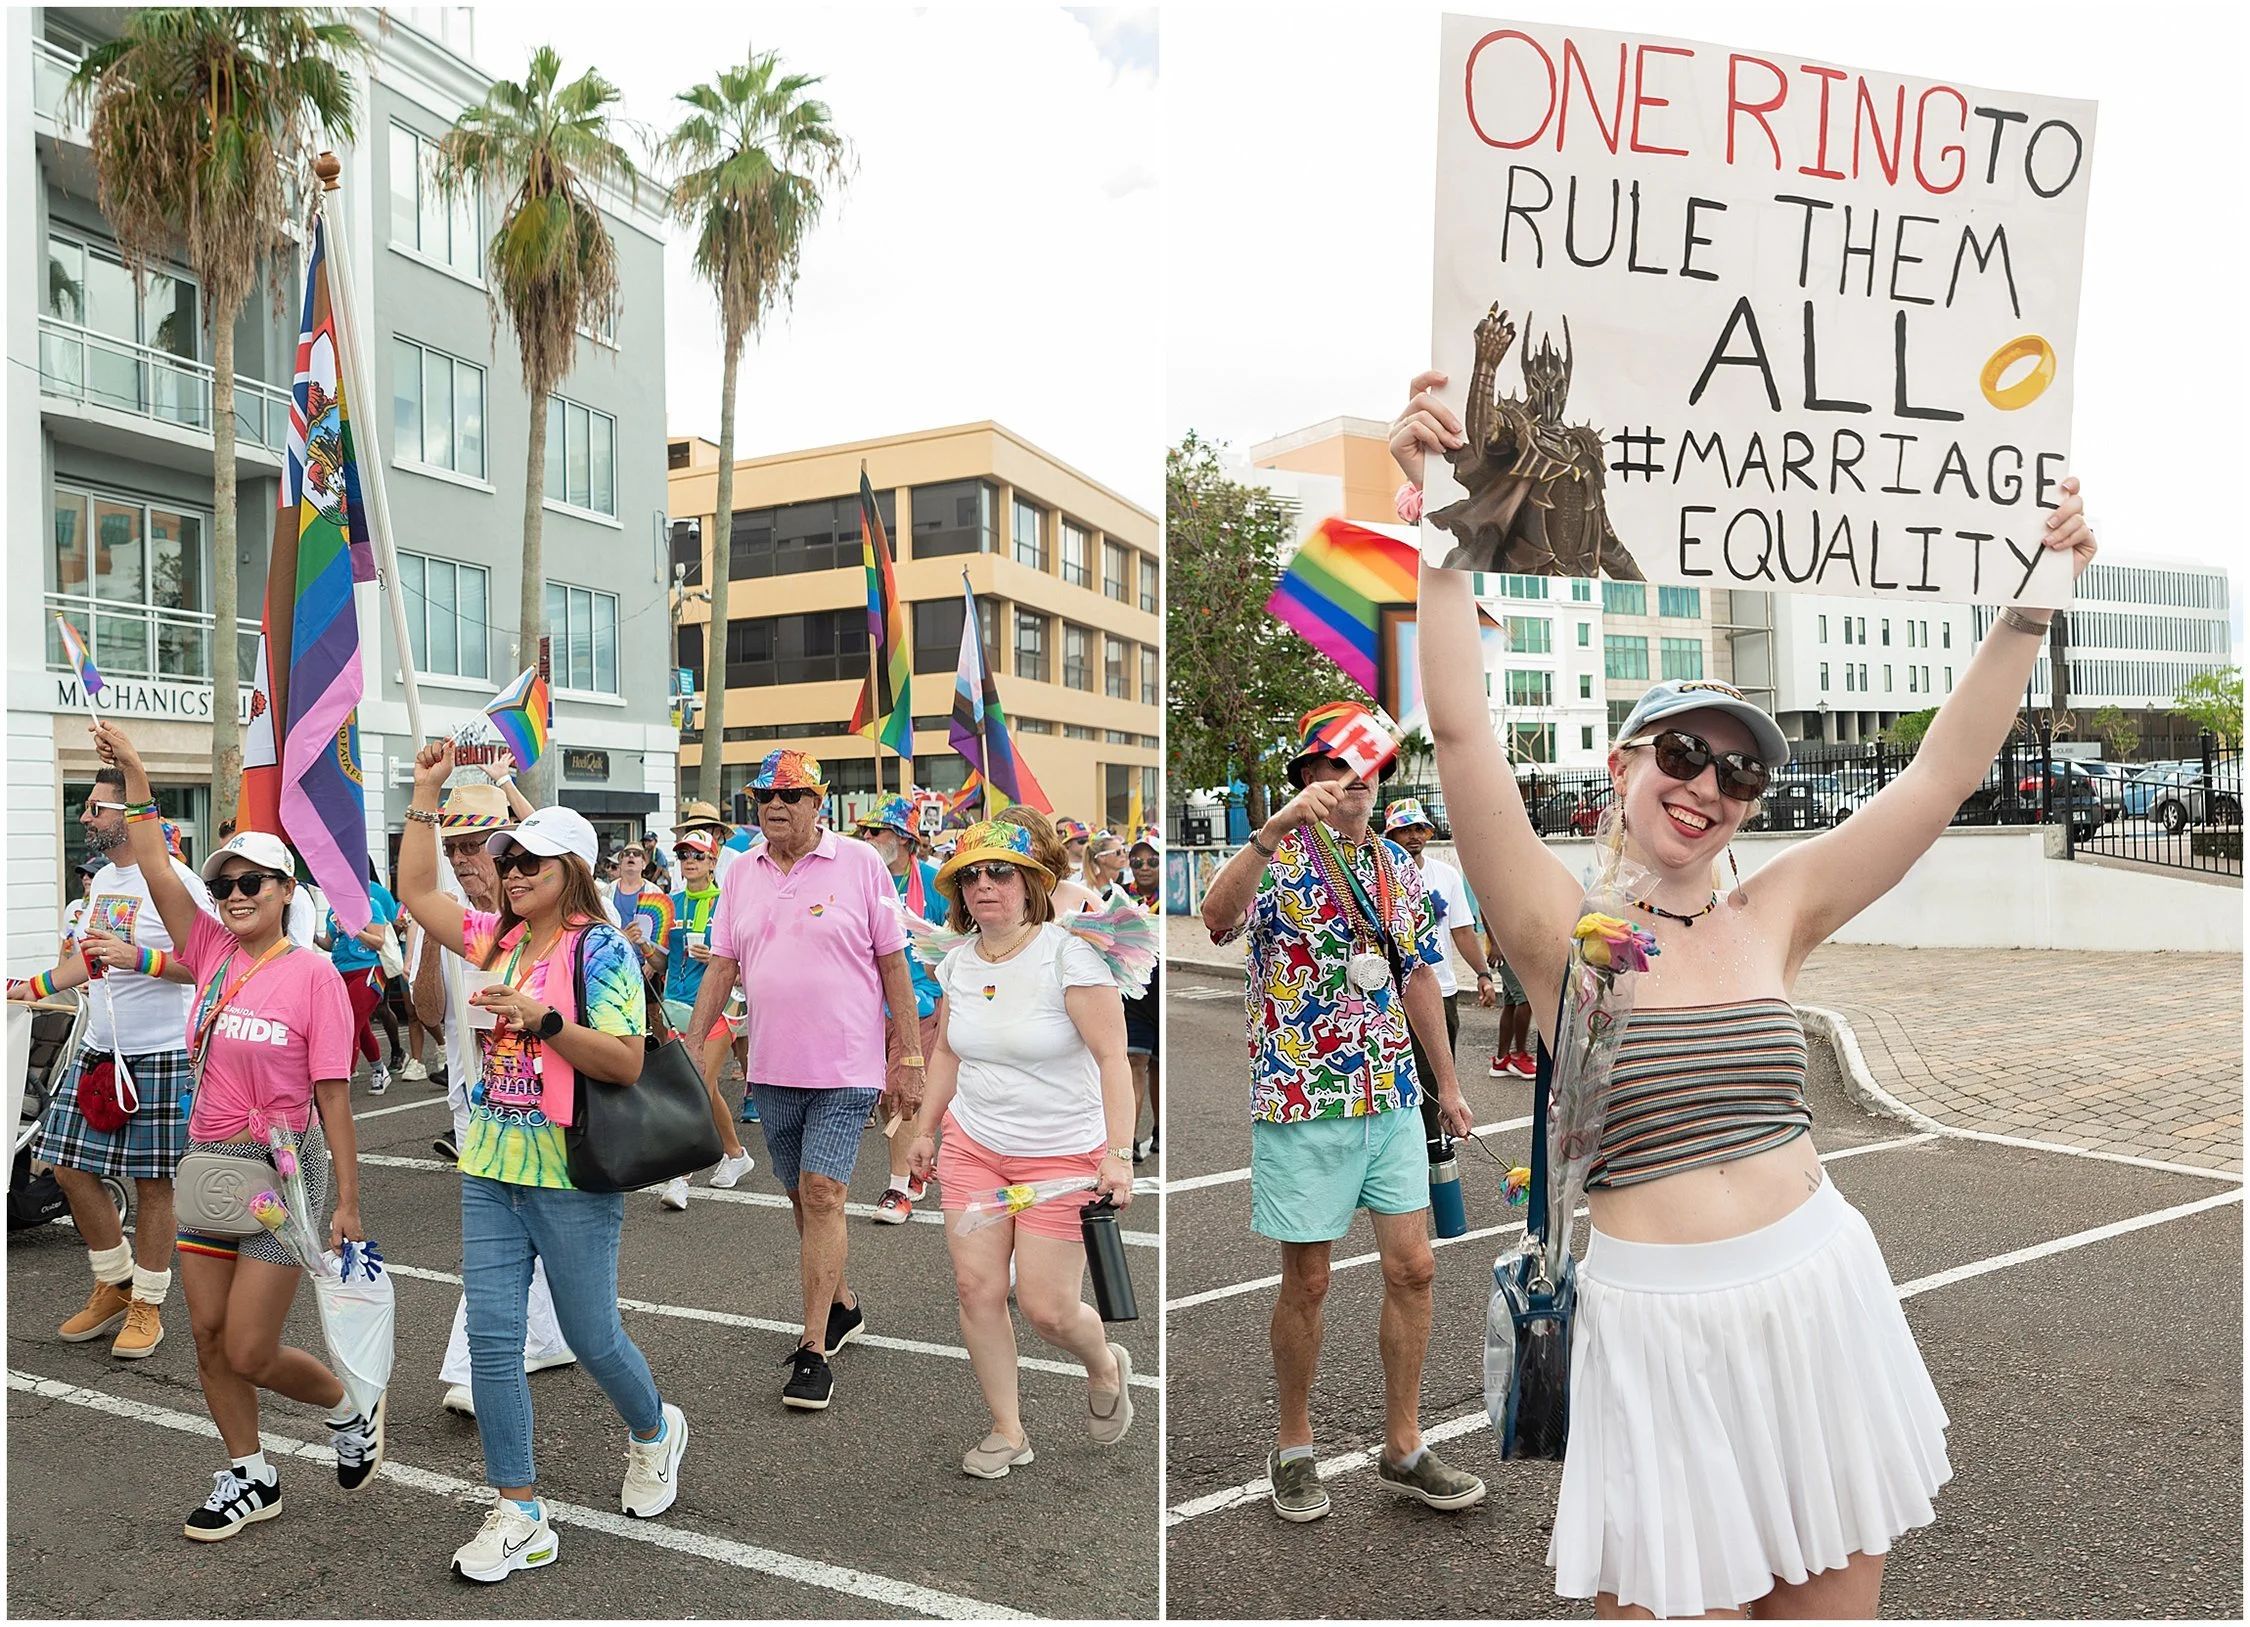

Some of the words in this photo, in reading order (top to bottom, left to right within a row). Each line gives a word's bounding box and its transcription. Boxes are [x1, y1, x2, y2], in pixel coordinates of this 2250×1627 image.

[1465, 29, 1694, 157] ONE
[1725, 53, 1969, 194] RING
[1974, 106, 2083, 198] TO
[1500, 165, 1728, 282] RULE
[1774, 194, 2020, 319] THEM
[1688, 296, 1965, 421] ALL
[1611, 425, 2067, 509] #MARRIAGE
[1680, 505, 2047, 599] EQUALITY
[58, 680, 212, 717] MCHANICS'
[213, 1012, 290, 1046] PRIDE
